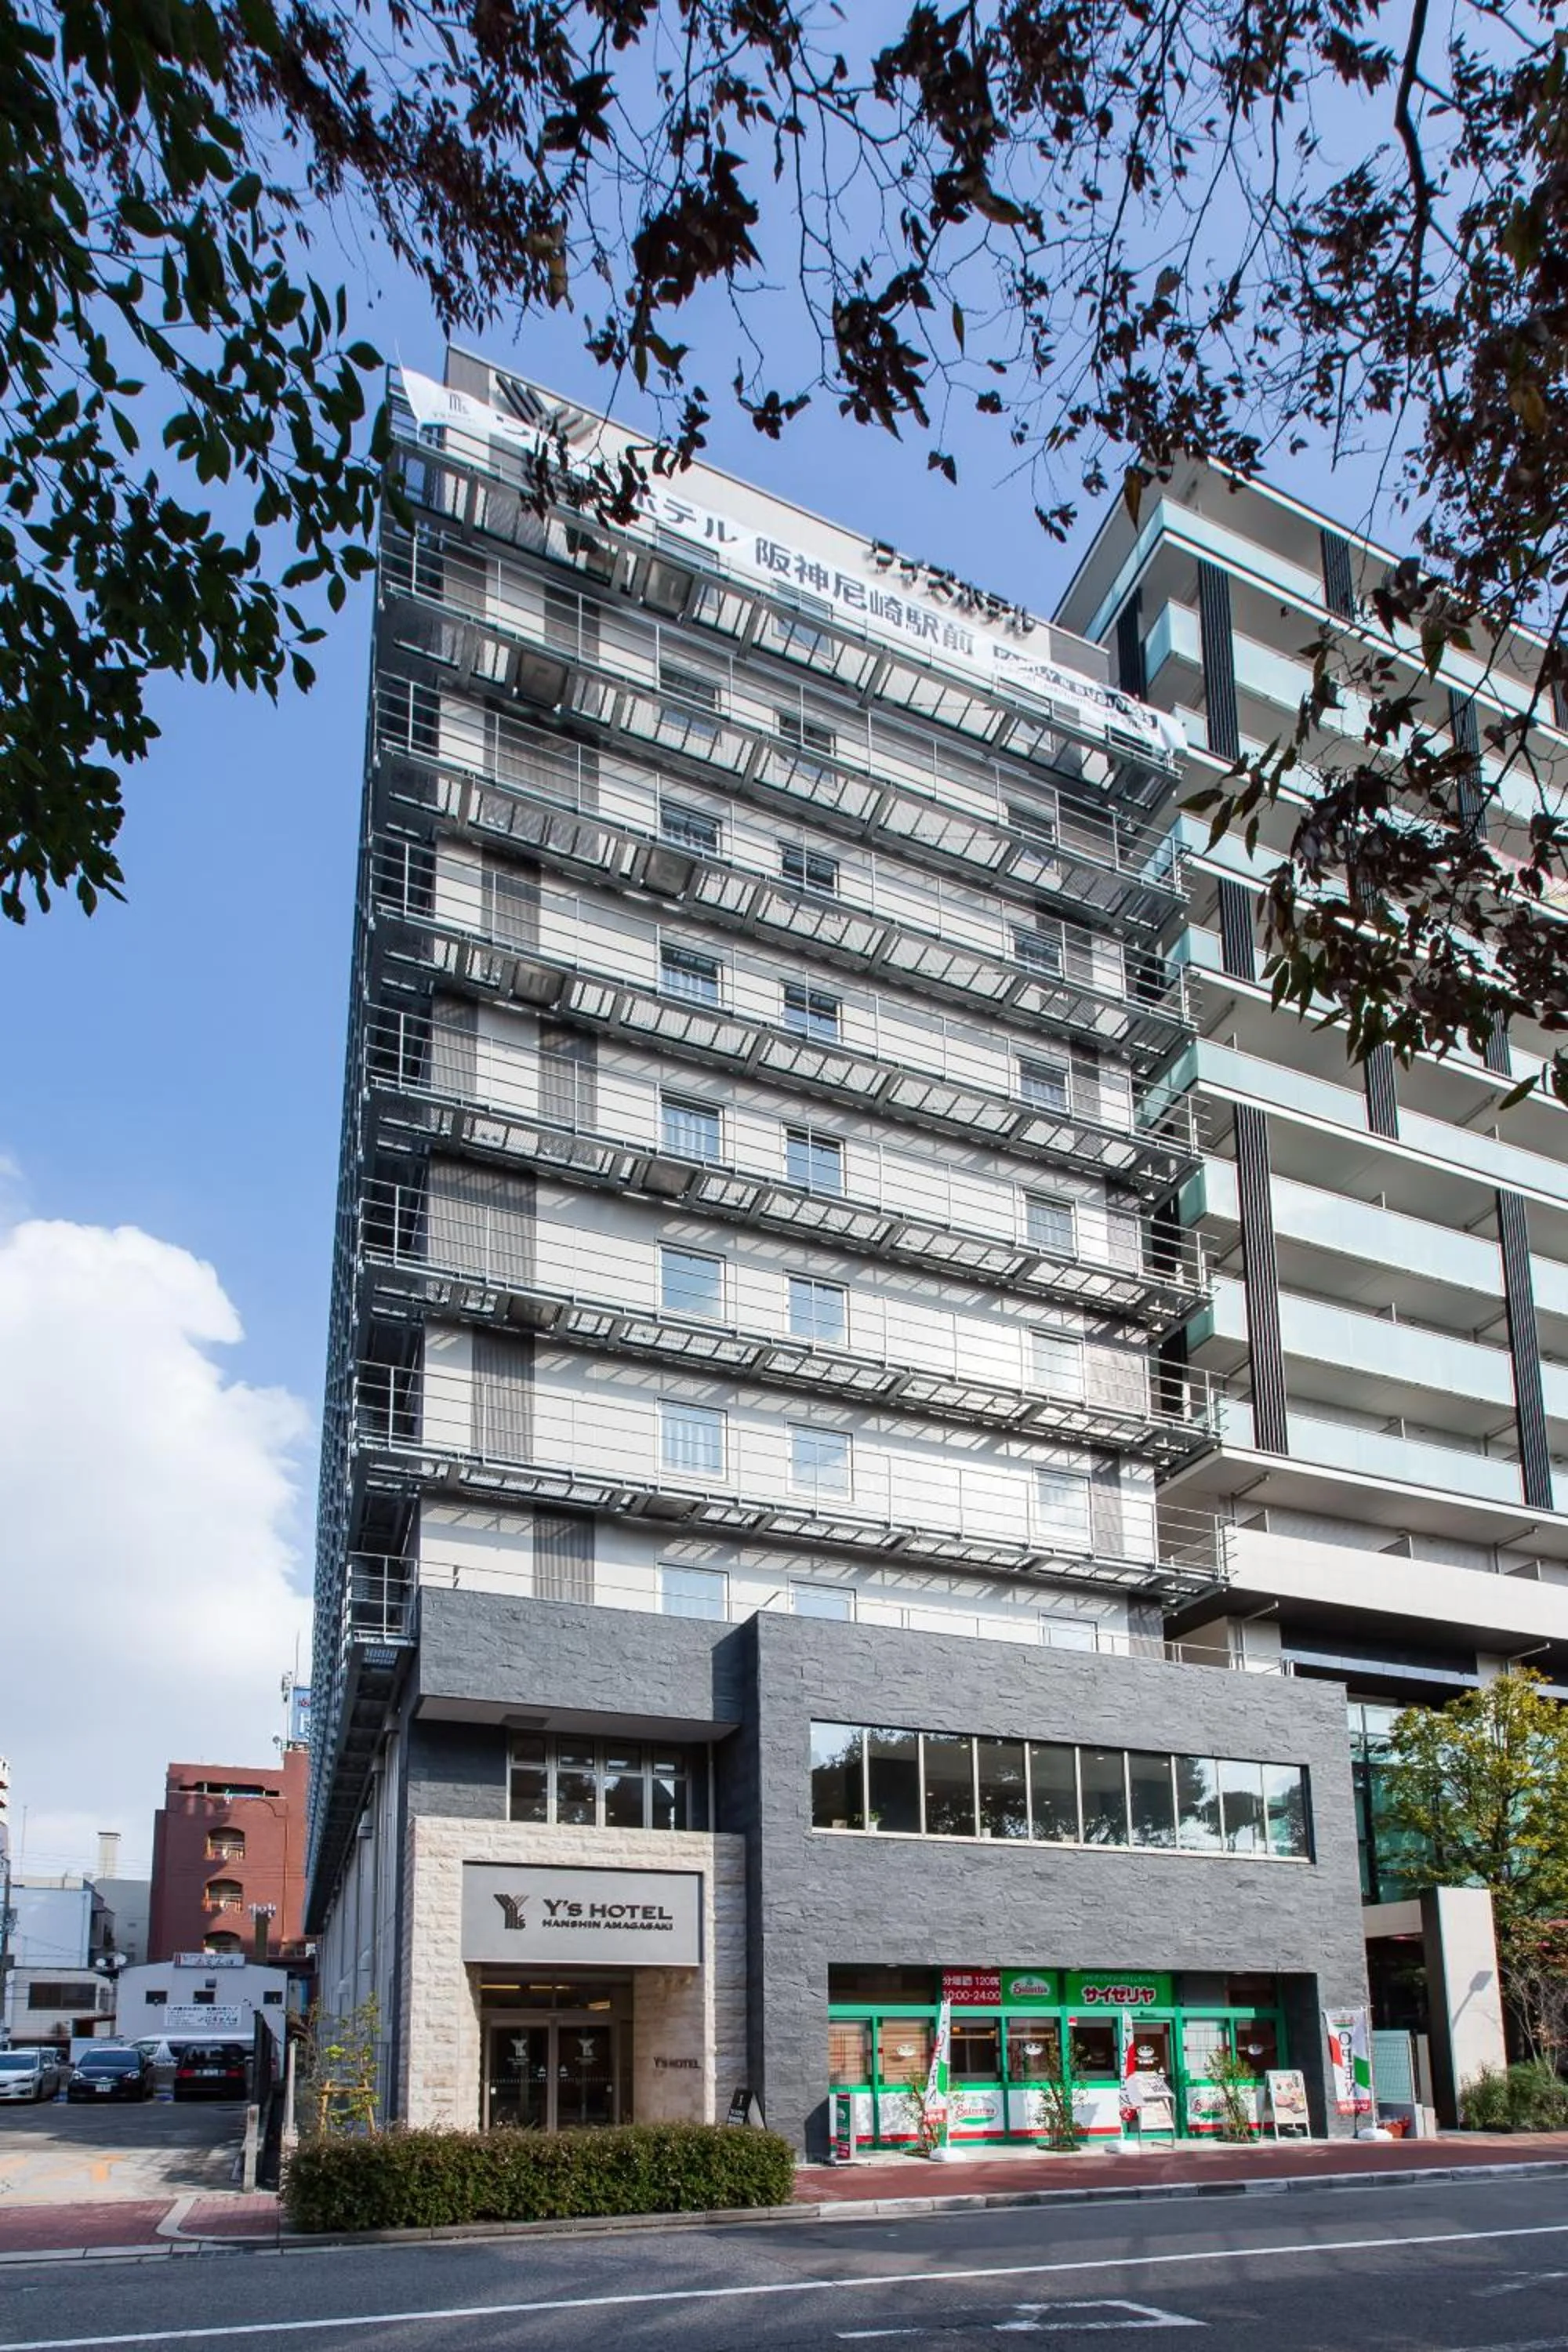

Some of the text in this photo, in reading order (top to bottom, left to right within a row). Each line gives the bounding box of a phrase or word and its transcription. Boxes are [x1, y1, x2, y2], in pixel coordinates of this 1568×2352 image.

[755, 536, 975, 657] 阪神尼崎駅前
[589, 1903, 673, 1920] HOTEL
[543, 1918, 673, 1930] HANSHIN AMAGASAKI
[1082, 1985, 1156, 2005] サイゼリヤ
